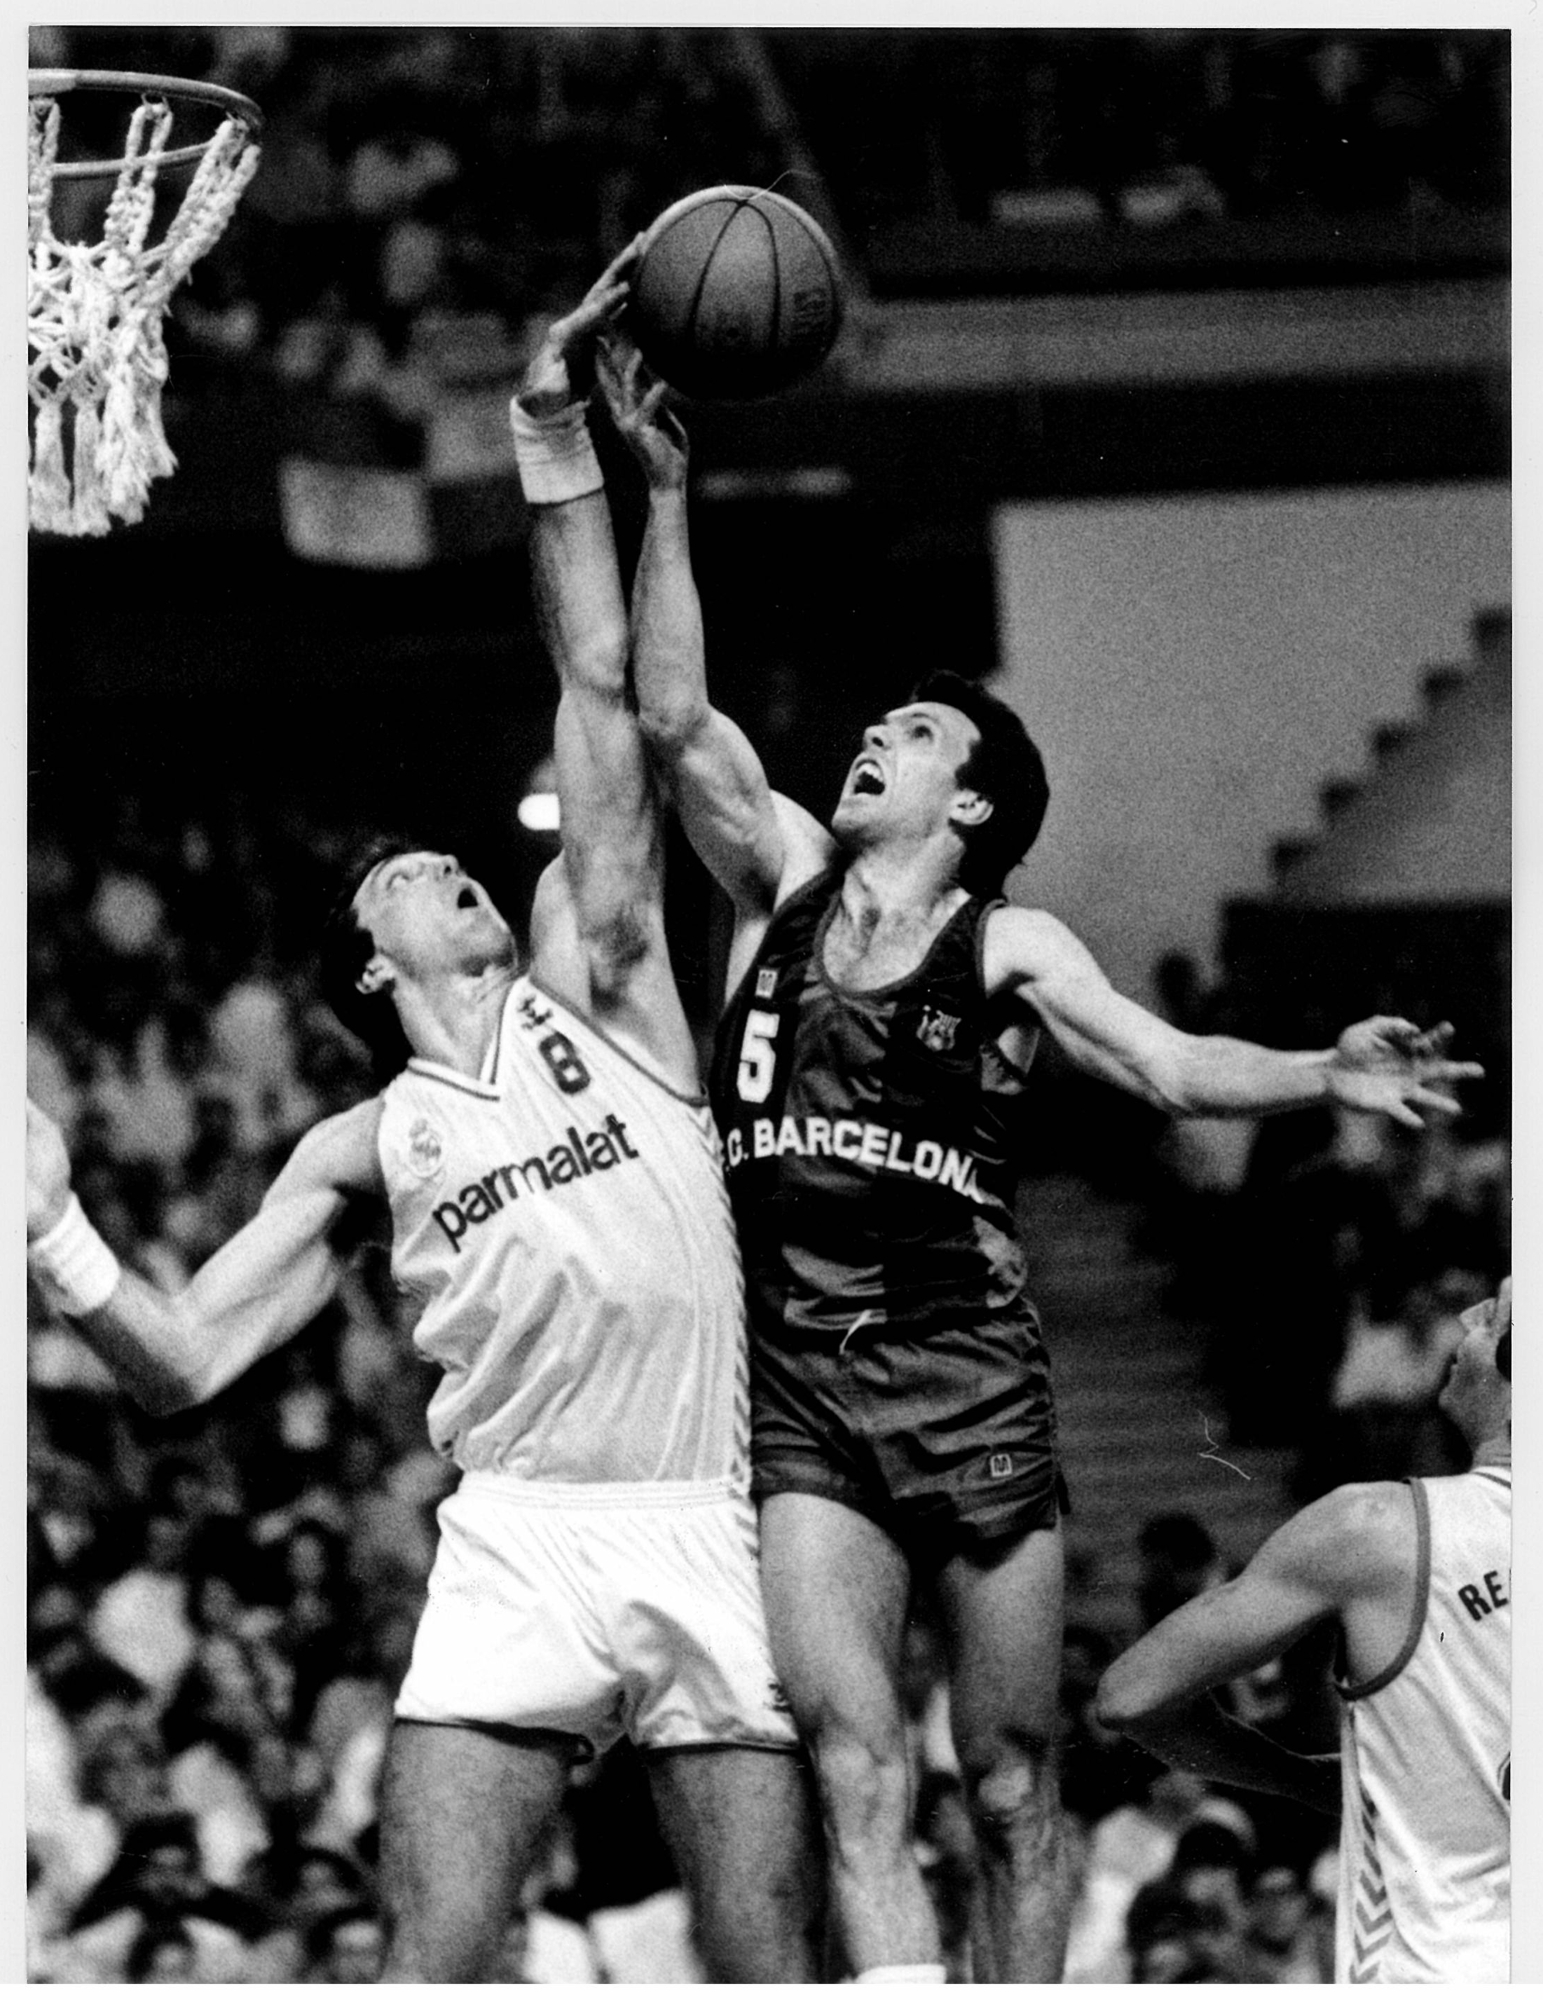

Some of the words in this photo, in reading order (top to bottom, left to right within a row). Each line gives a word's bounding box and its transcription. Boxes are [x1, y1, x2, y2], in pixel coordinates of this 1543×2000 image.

[538, 1030, 592, 1095] 8
[736, 1008, 780, 1104] 5
[432, 1113, 639, 1254] parmalat
[1458, 1568, 1511, 1622] RE
